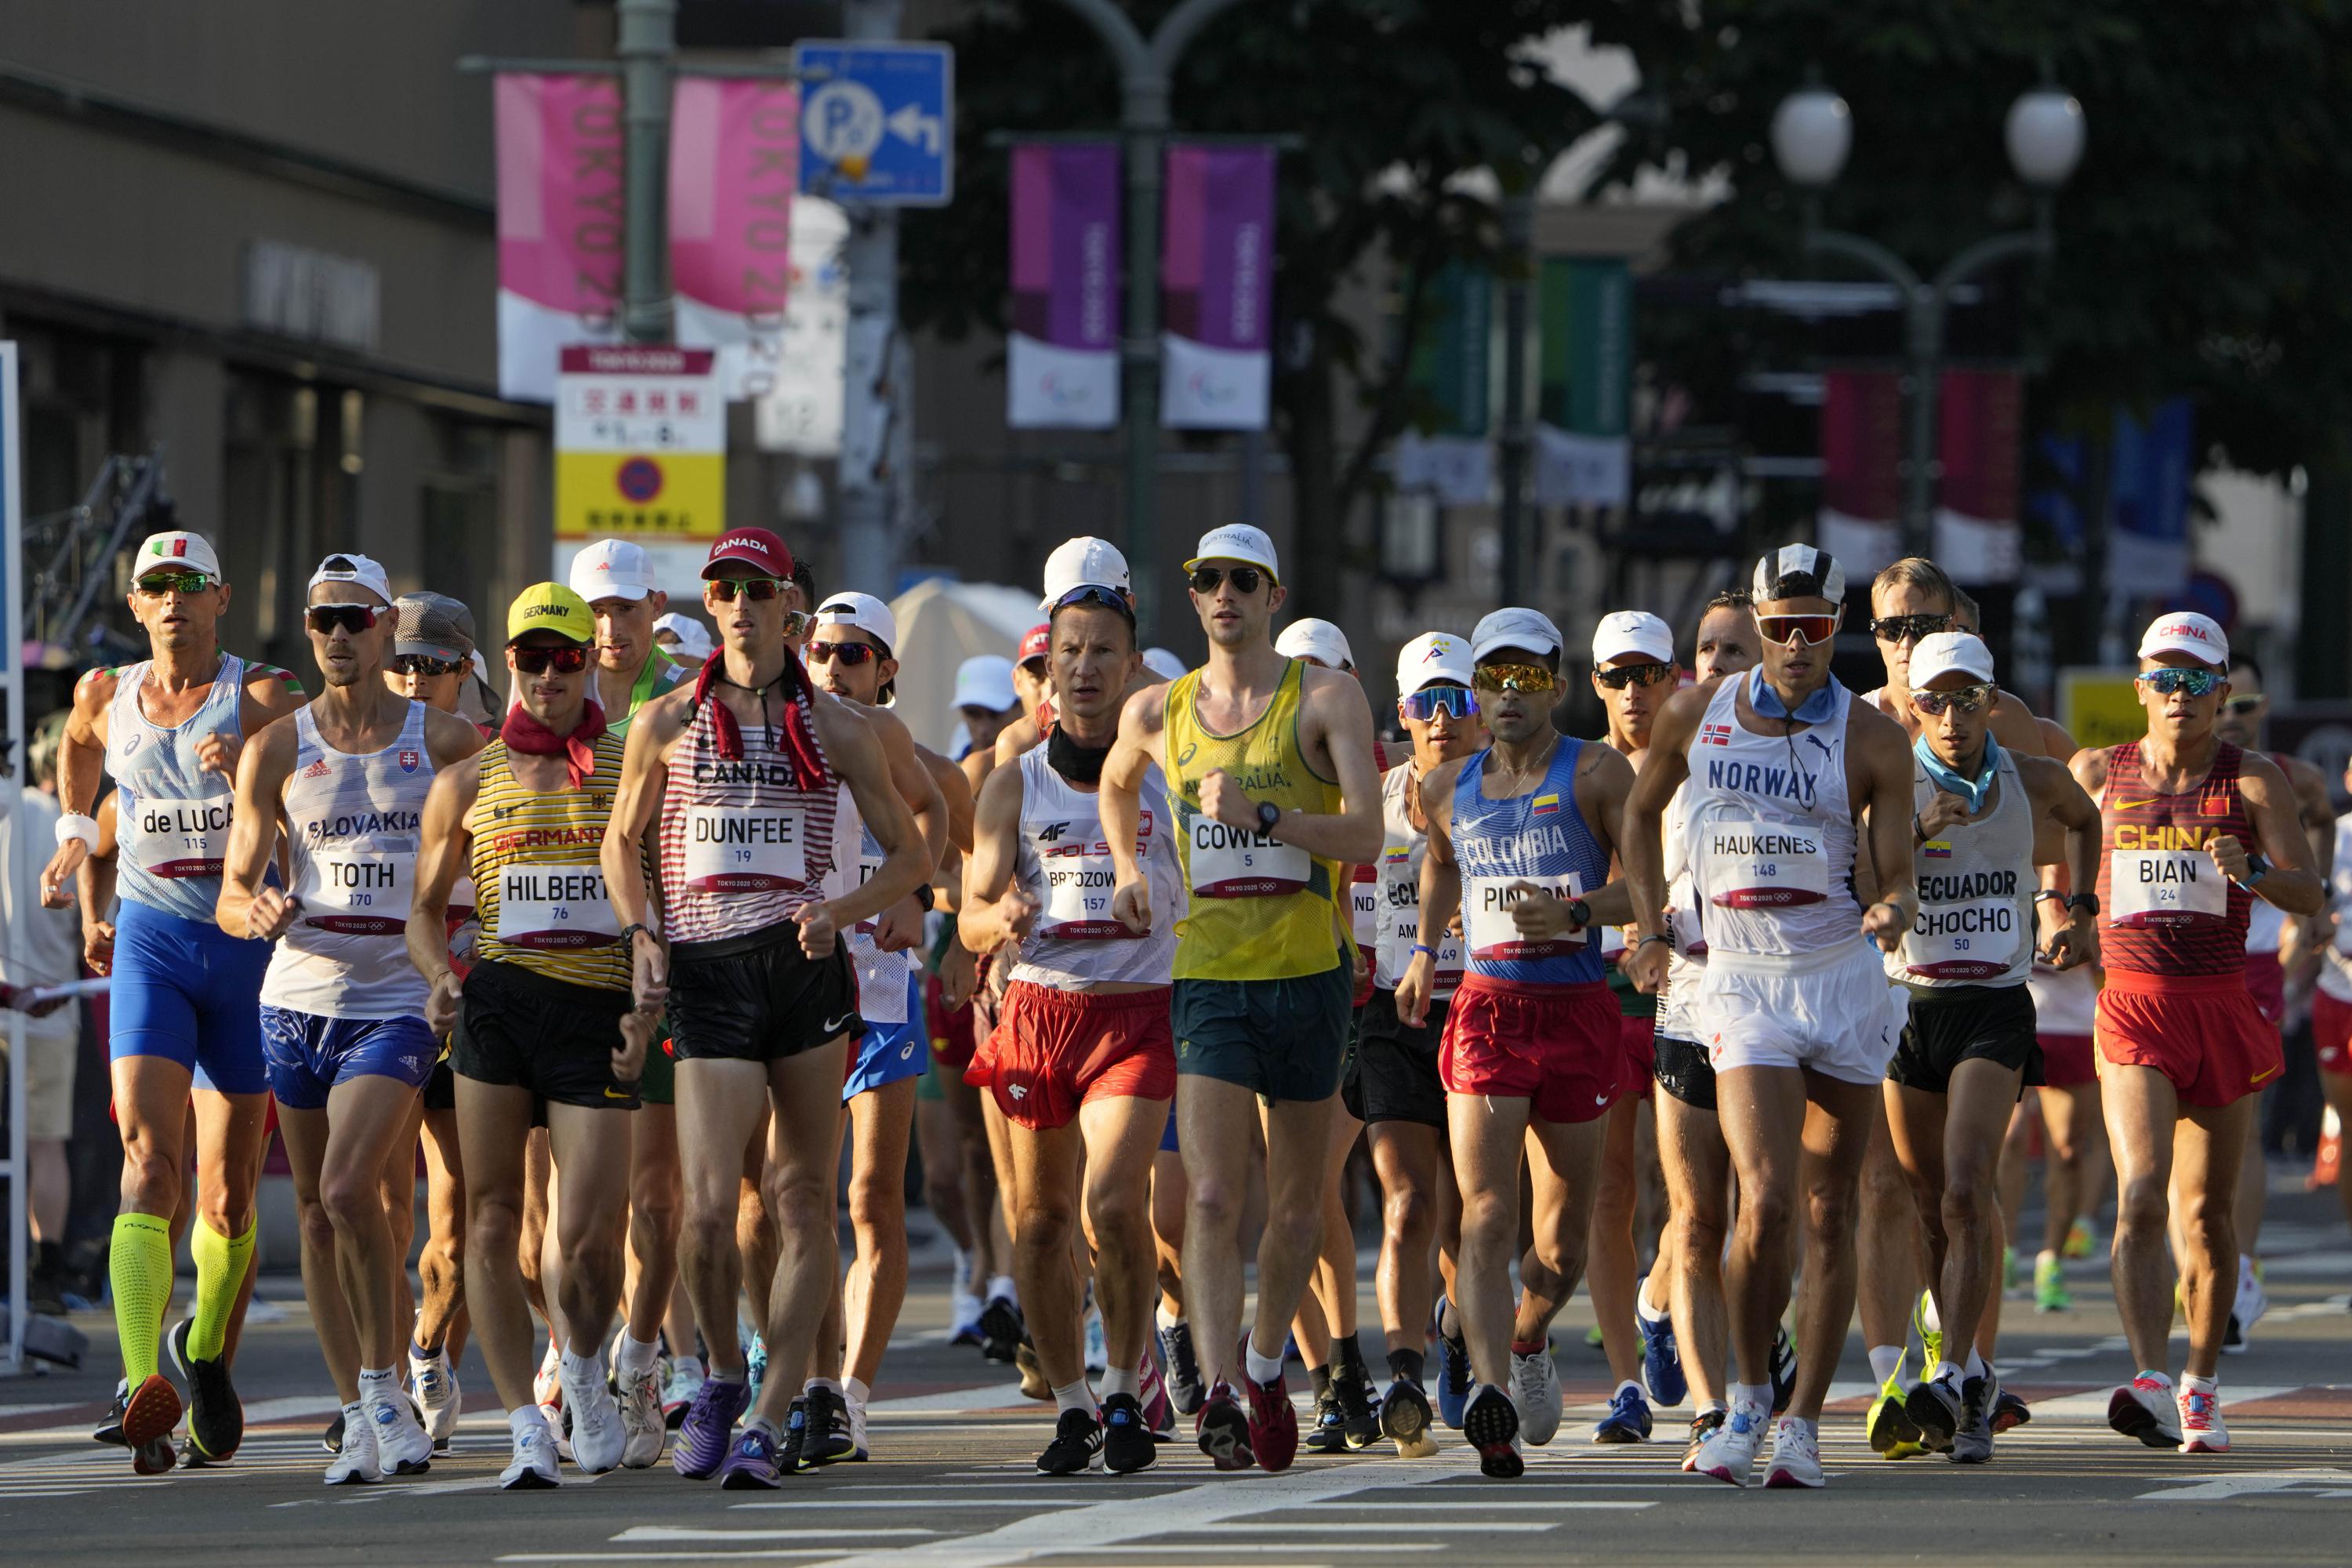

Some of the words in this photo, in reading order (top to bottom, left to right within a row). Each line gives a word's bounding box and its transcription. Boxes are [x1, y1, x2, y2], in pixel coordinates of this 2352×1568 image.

[714, 538, 768, 556] CANADA
[1205, 533, 1251, 546] AUSTRALIA
[524, 604, 569, 619] GERMANY
[2160, 625, 2208, 641] CHINA
[304, 767, 332, 779] adidas
[1709, 760, 1817, 801] NORWAY
[144, 809, 171, 833] de
[308, 811, 421, 839] SLOVAKIA
[696, 818, 793, 844] DUNFEE
[184, 838, 207, 849] 115
[493, 826, 608, 852] GERMANY
[1464, 825, 1569, 866] COLOMBIA
[1714, 836, 1817, 855] HAUKENES
[735, 851, 751, 862] 19
[1046, 842, 1147, 857] POLSA
[1245, 855, 1253, 866] 5
[330, 862, 394, 887] TOTH
[1752, 864, 1776, 877] 148
[2140, 859, 2197, 883] BIAN
[507, 876, 609, 901] HILBERT
[1918, 870, 2017, 901] ECUADOR
[349, 894, 372, 906] 170
[2161, 889, 2176, 900] 24
[1083, 898, 1105, 909] 157
[553, 907, 568, 920] 76
[1914, 908, 2011, 936] CHOCHO
[1955, 939, 1969, 950] 50
[1441, 949, 1457, 961] 49
